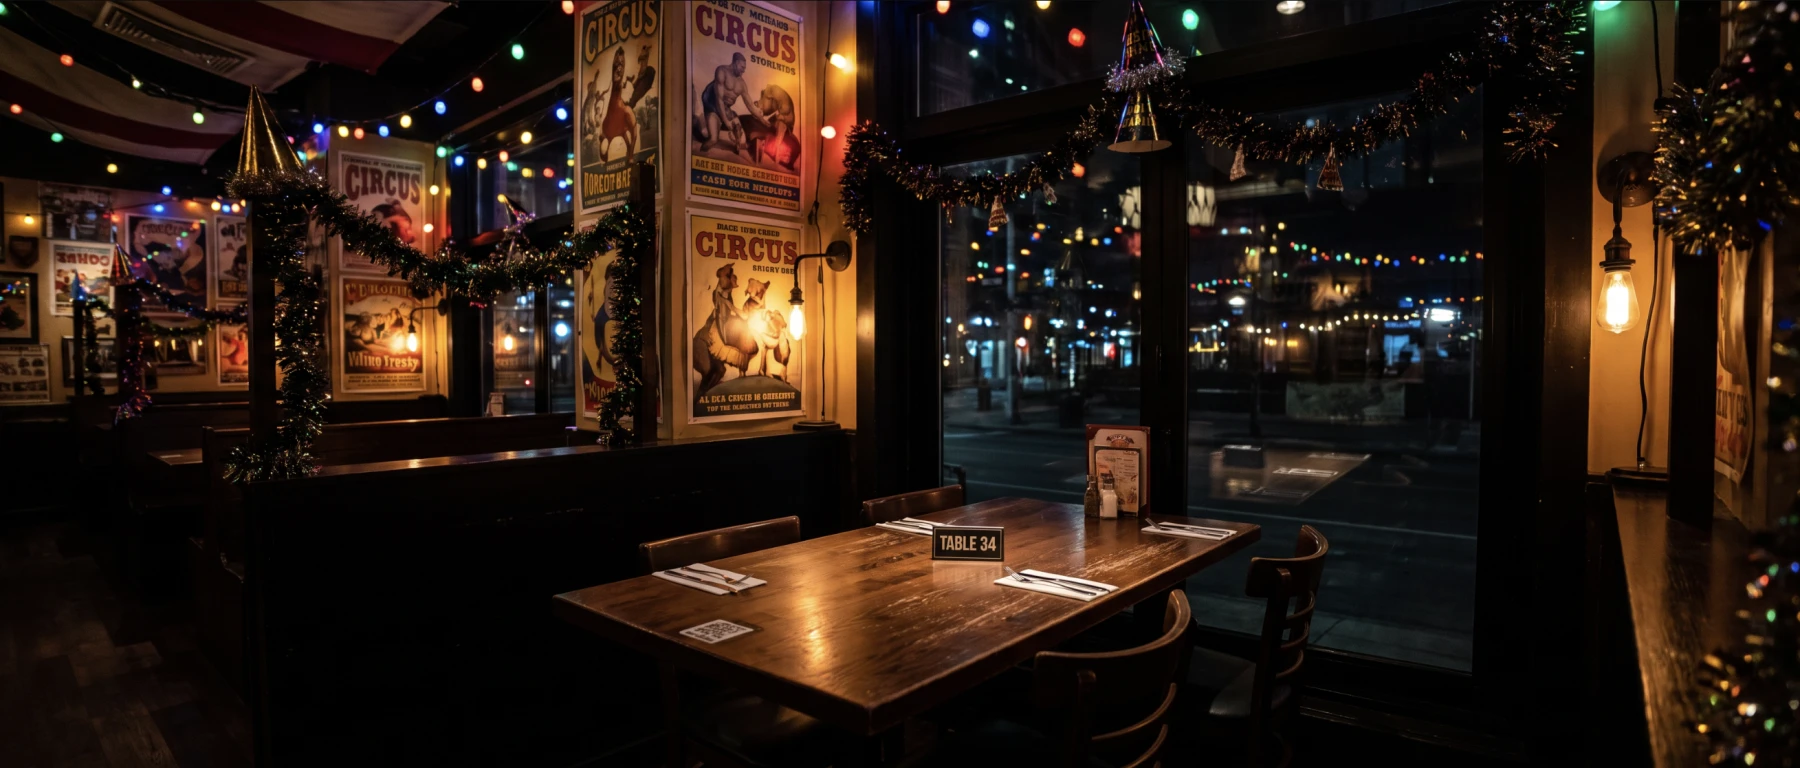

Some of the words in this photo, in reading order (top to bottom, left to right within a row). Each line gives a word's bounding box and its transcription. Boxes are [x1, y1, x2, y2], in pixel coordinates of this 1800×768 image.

[585, 1, 657, 63] CIRCUS
[695, 5, 796, 64] CIRCUS
[345, 164, 421, 205] CIRCUS
[695, 231, 798, 265] CIRCUS
[940, 535, 977, 551] TABLE
[980, 536, 996, 551] 34
